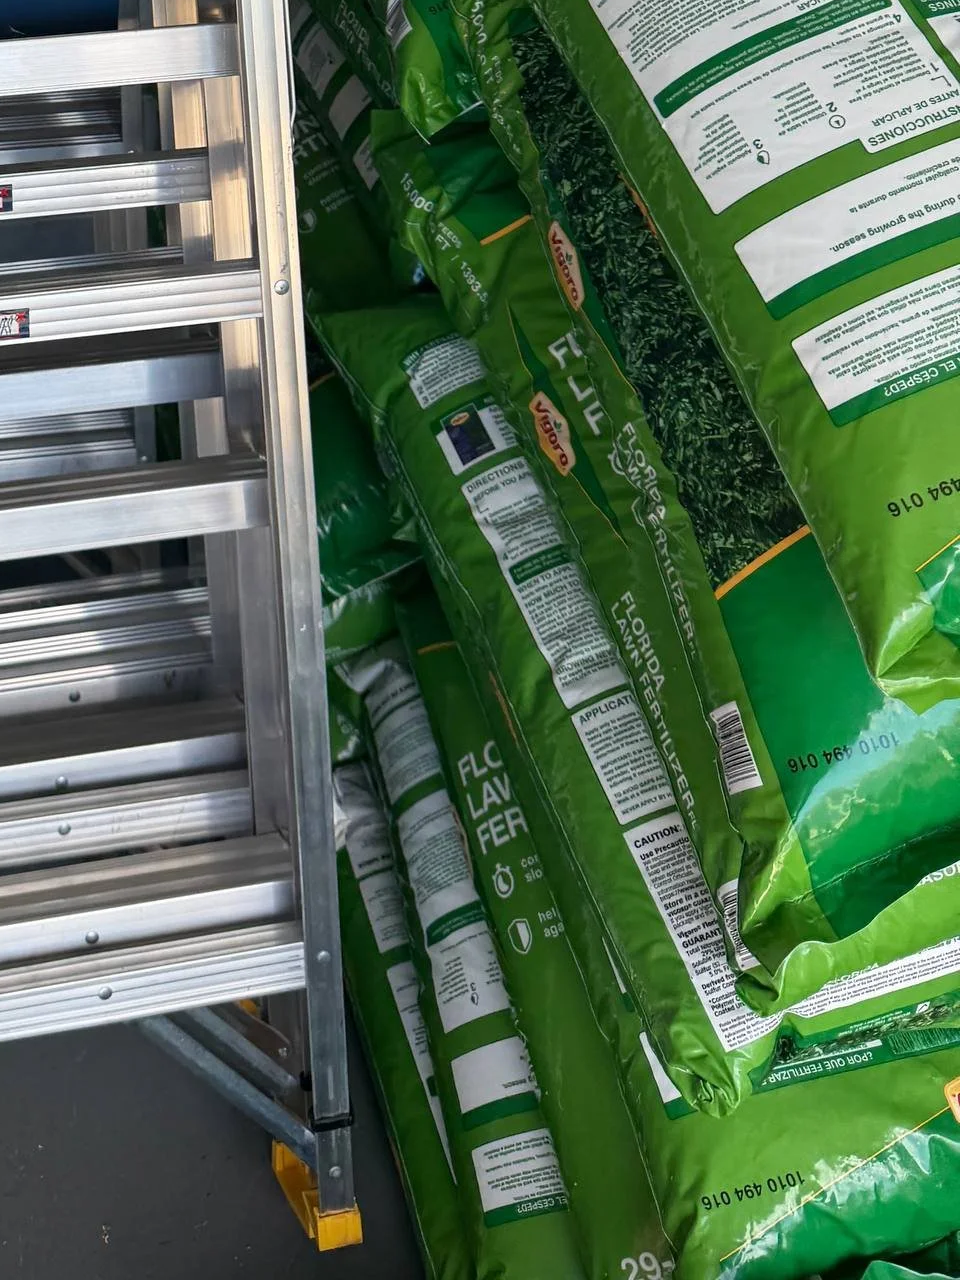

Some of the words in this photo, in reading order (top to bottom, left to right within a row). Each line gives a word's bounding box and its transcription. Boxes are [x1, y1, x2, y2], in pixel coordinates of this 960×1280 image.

[914, 99, 928, 109] DE
[928, 88, 960, 104] ANTES
[825, 101, 838, 113] 2
[871, 106, 913, 127] APLICAR
[752, 139, 764, 150] 3
[888, 180, 924, 197] momento
[849, 206, 858, 214] la
[858, 194, 887, 210] durante
[924, 197, 956, 213] during
[907, 209, 924, 221] the
[866, 214, 907, 236] growing
[829, 232, 867, 254] season.
[938, 360, 957, 372] EL
[883, 367, 939, 397] CÉSPED?
[534, 400, 570, 468] Vigoro
[887, 492, 924, 517] 016
[620, 591, 666, 694] FLORIDA
[610, 601, 642, 669] LAWN
[638, 671, 696, 815] FERTILIZER
[858, 731, 900, 755] 1010
[787, 753, 819, 773] 016
[822, 744, 853, 766] 494
[639, 851, 654, 861] Use
[663, 897, 684, 911] Store
[701, 976, 725, 990] Derived
[823, 1057, 845, 1072] QUÉ
[846, 1050, 873, 1065] ¿POR
[768, 1062, 823, 1083] FERTILIZAR
[766, 1171, 805, 1193] 1010
[701, 1190, 731, 1211] 016
[734, 1182, 763, 1202] 494
